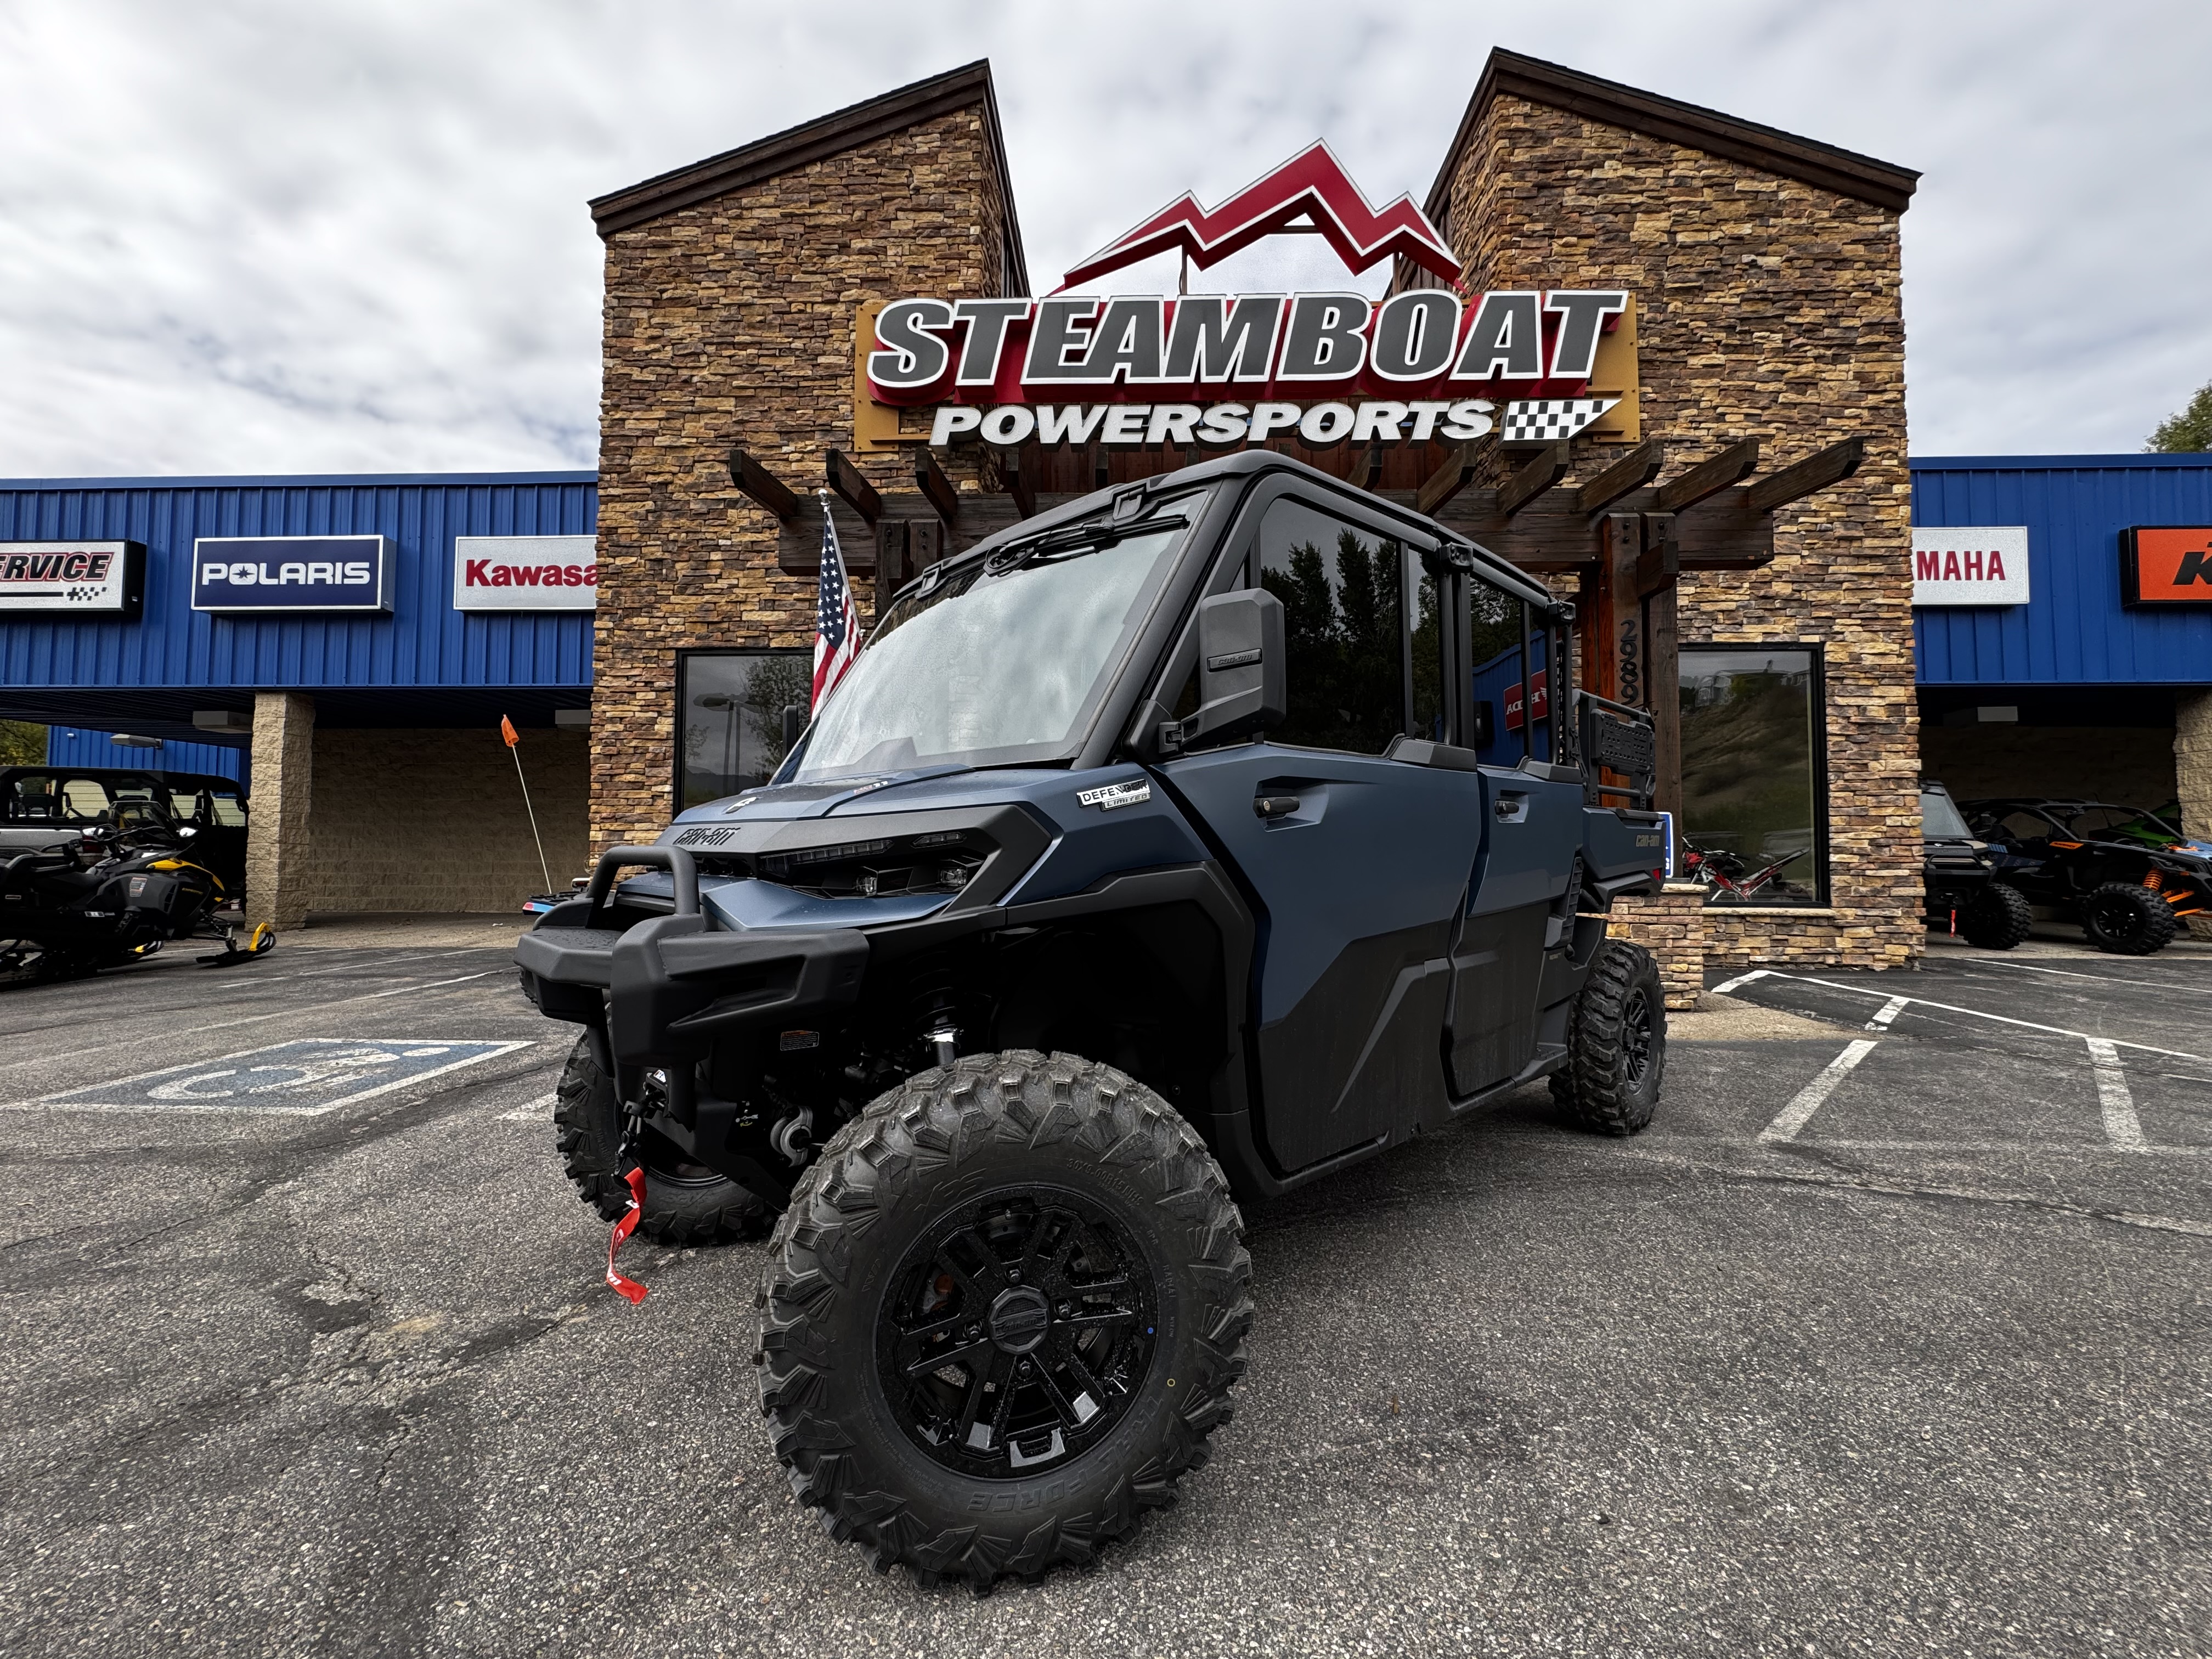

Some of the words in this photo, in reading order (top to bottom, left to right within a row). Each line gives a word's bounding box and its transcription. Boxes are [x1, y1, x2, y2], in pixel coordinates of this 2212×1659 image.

[867, 290, 1629, 388] STEAMBOAT
[929, 399, 1494, 446] POWERSPORTS
[0, 552, 114, 582] RVICE
[202, 562, 371, 585] POLARIS
[466, 559, 597, 586] Kawasa
[1911, 551, 2006, 581] MAHA
[1620, 619, 1639, 704] 2989
[1082, 781, 1147, 802] DEFENDER
[1107, 794, 1147, 806] LIMITED
[967, 1468, 1088, 1513] FORCE
